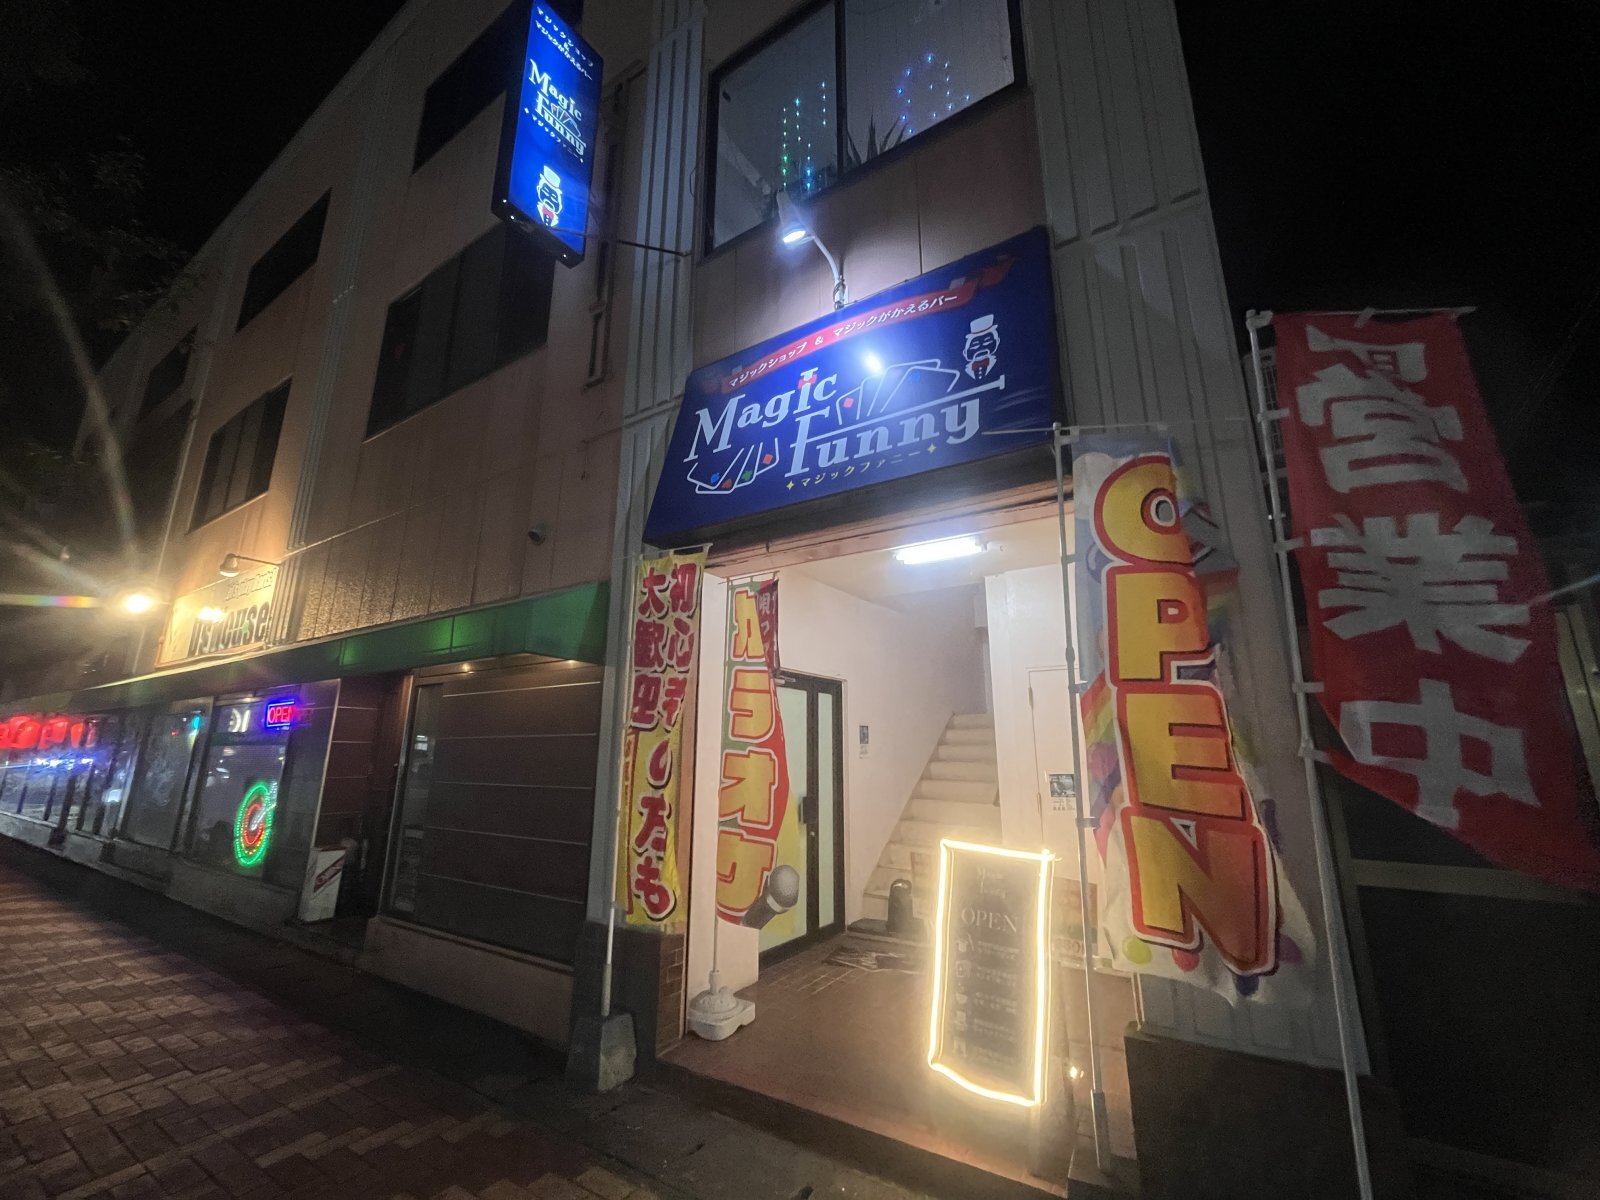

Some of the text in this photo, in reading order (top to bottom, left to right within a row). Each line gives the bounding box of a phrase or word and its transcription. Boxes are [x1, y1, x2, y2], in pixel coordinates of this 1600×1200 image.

[528, 58, 582, 121] Magic
[534, 91, 587, 156] Funny
[727, 293, 958, 388] マジックショップ & マジックがかえるバー
[683, 368, 837, 463] Magic
[785, 375, 1005, 478] Funny
[801, 449, 921, 488] マジックファニー
[1296, 324, 1542, 830] 営業中
[717, 588, 776, 913] カラオケ
[1092, 454, 1278, 974] OPEN
[960, 906, 1019, 933] OPEN
